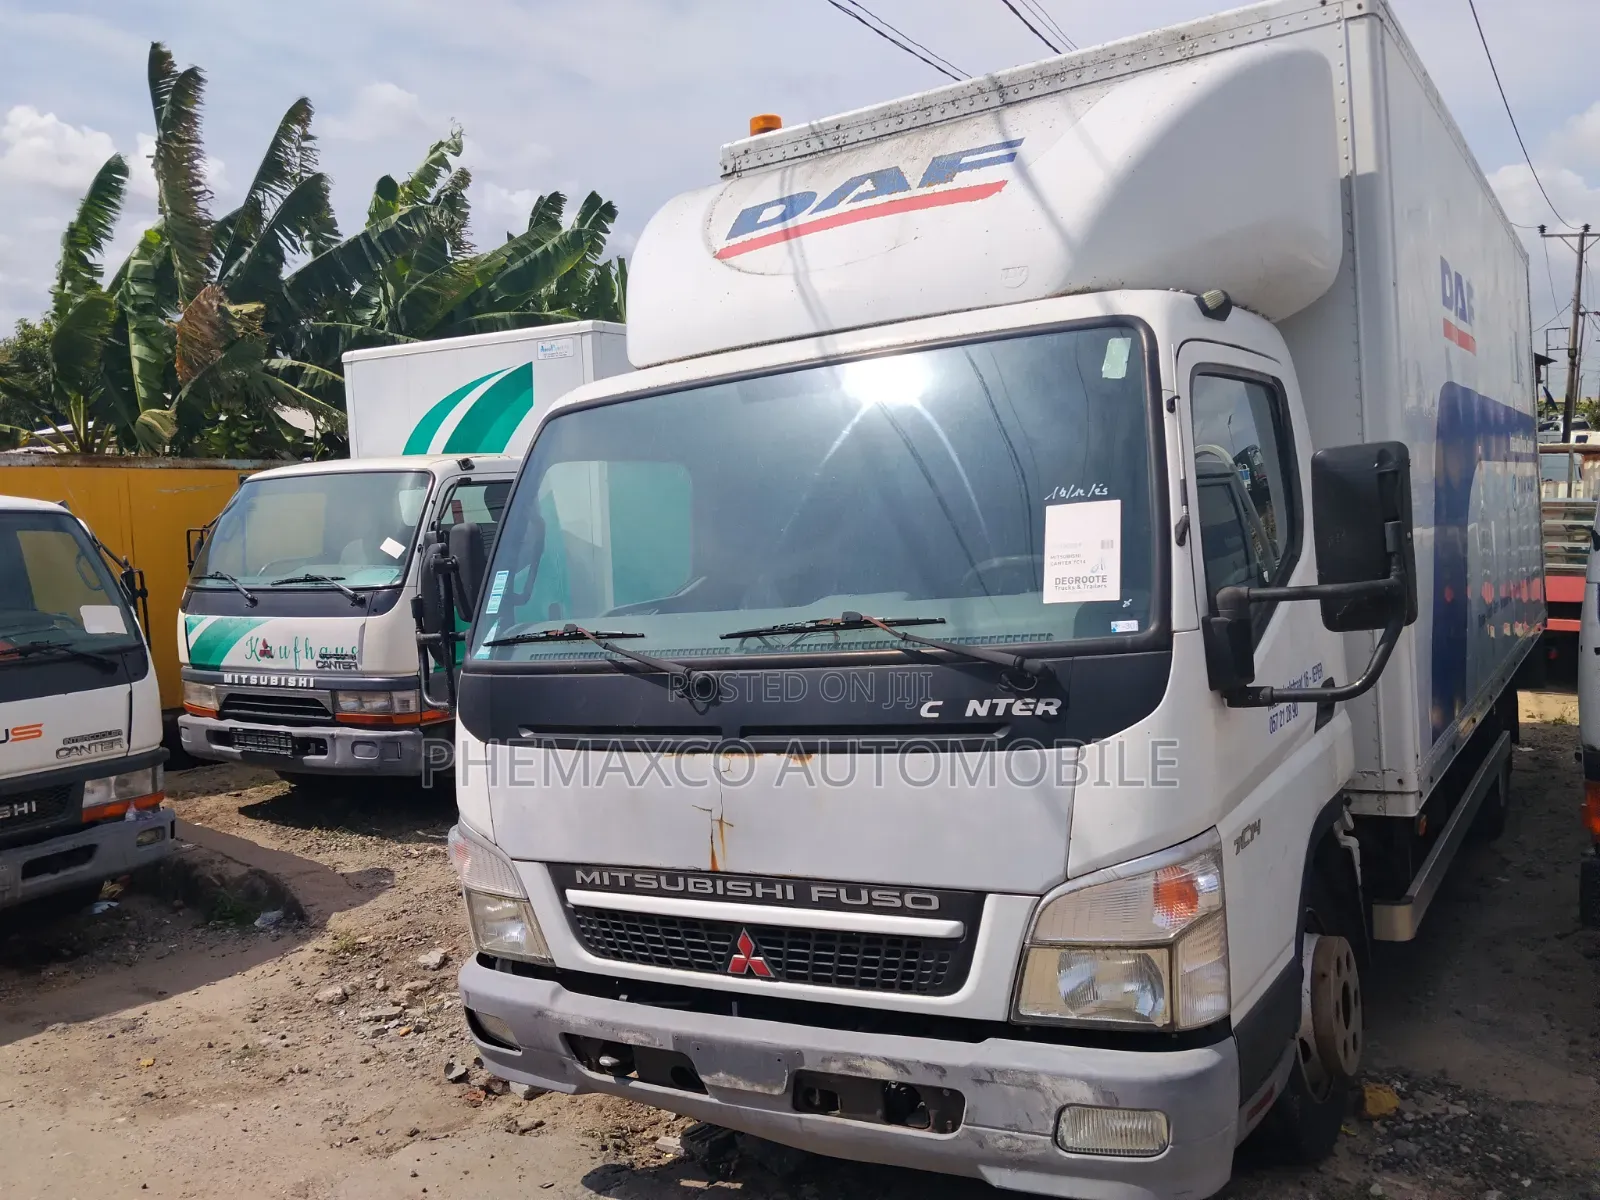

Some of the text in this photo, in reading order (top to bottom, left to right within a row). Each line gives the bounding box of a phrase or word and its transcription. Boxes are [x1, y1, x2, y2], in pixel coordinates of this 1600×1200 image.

[725, 137, 1025, 241] DAF
[1054, 575, 1108, 586] DEGROOTE
[316, 660, 358, 670] CANTER
[223, 674, 316, 687] MITSUBISHI
[63, 729, 123, 745] INTERCOOLER
[56, 738, 124, 760] CANTER
[575, 870, 941, 912] MITSUBISHI FUSO
